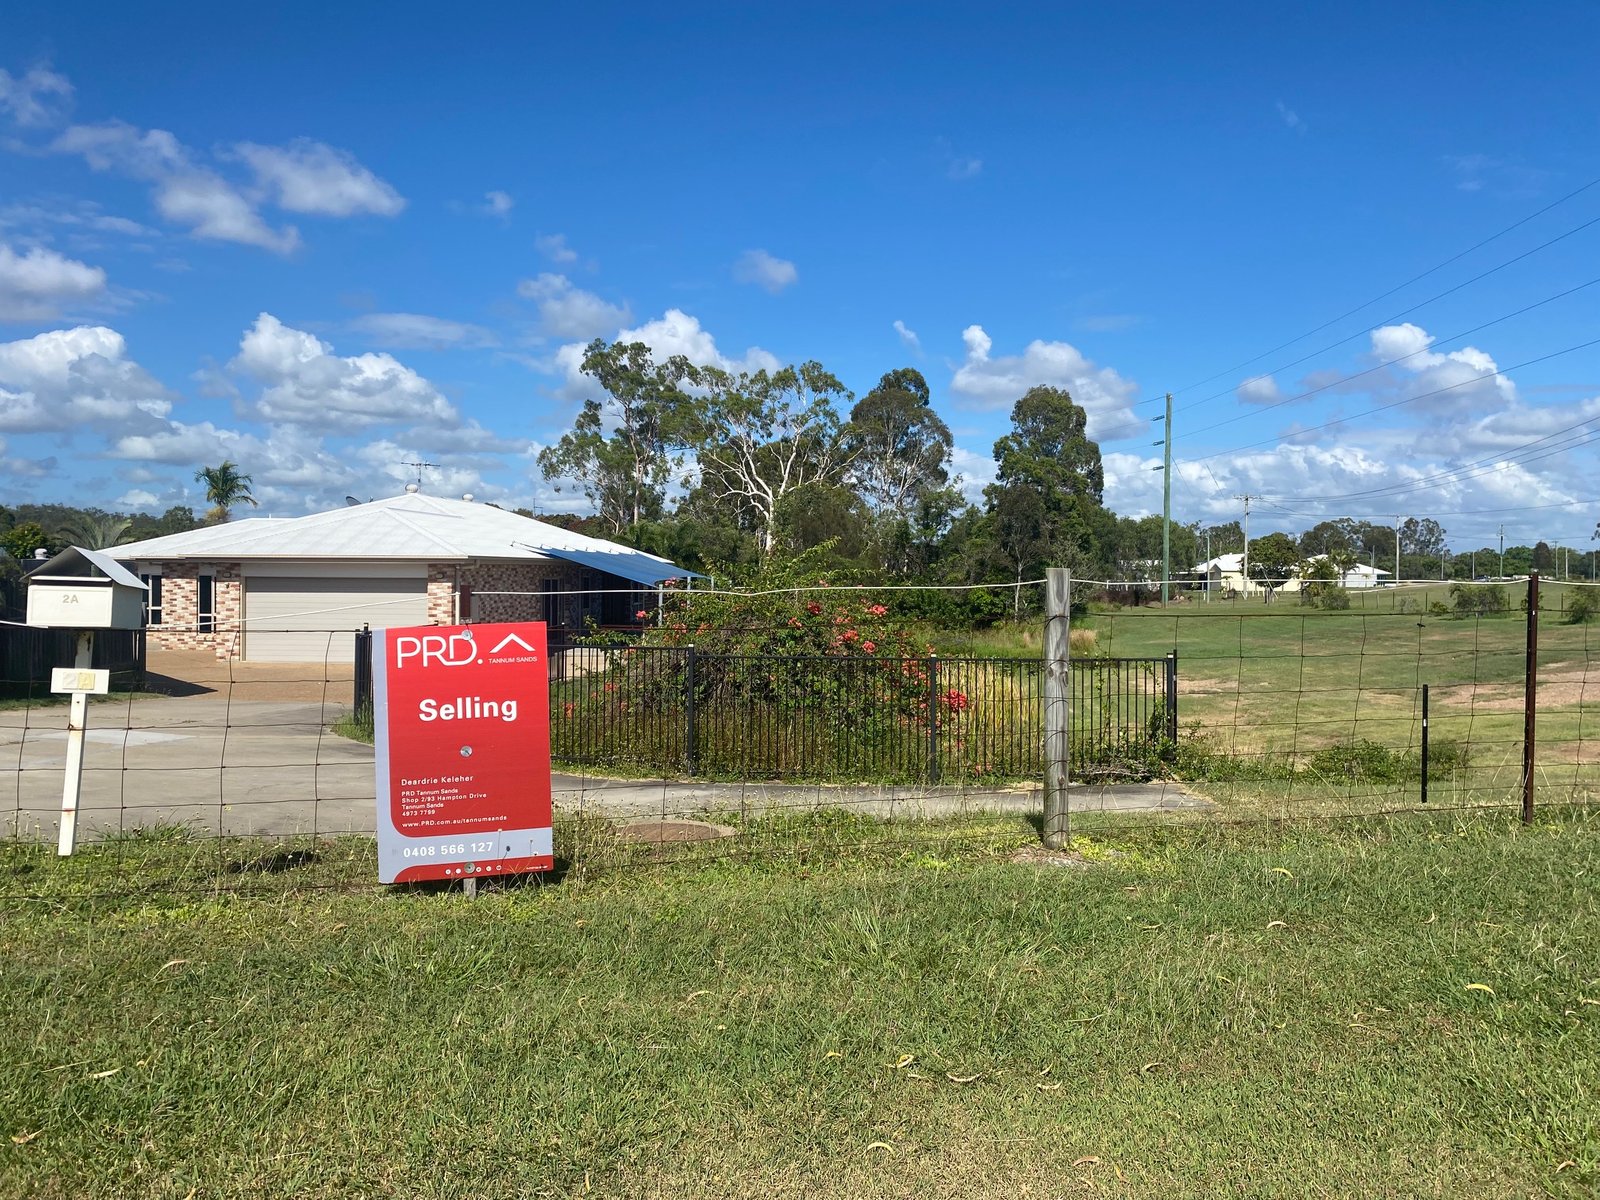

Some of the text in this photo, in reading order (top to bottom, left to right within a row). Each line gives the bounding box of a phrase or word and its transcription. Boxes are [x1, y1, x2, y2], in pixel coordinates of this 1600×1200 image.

[62, 594, 79, 604] 2A
[419, 697, 517, 721] Selling
[401, 775, 473, 786] Deardrie Keleher
[437, 794, 467, 802] Hampton
[469, 792, 487, 800] Drive
[403, 847, 435, 857] 0408
[440, 844, 465, 855] 566
[471, 842, 493, 853] 127
